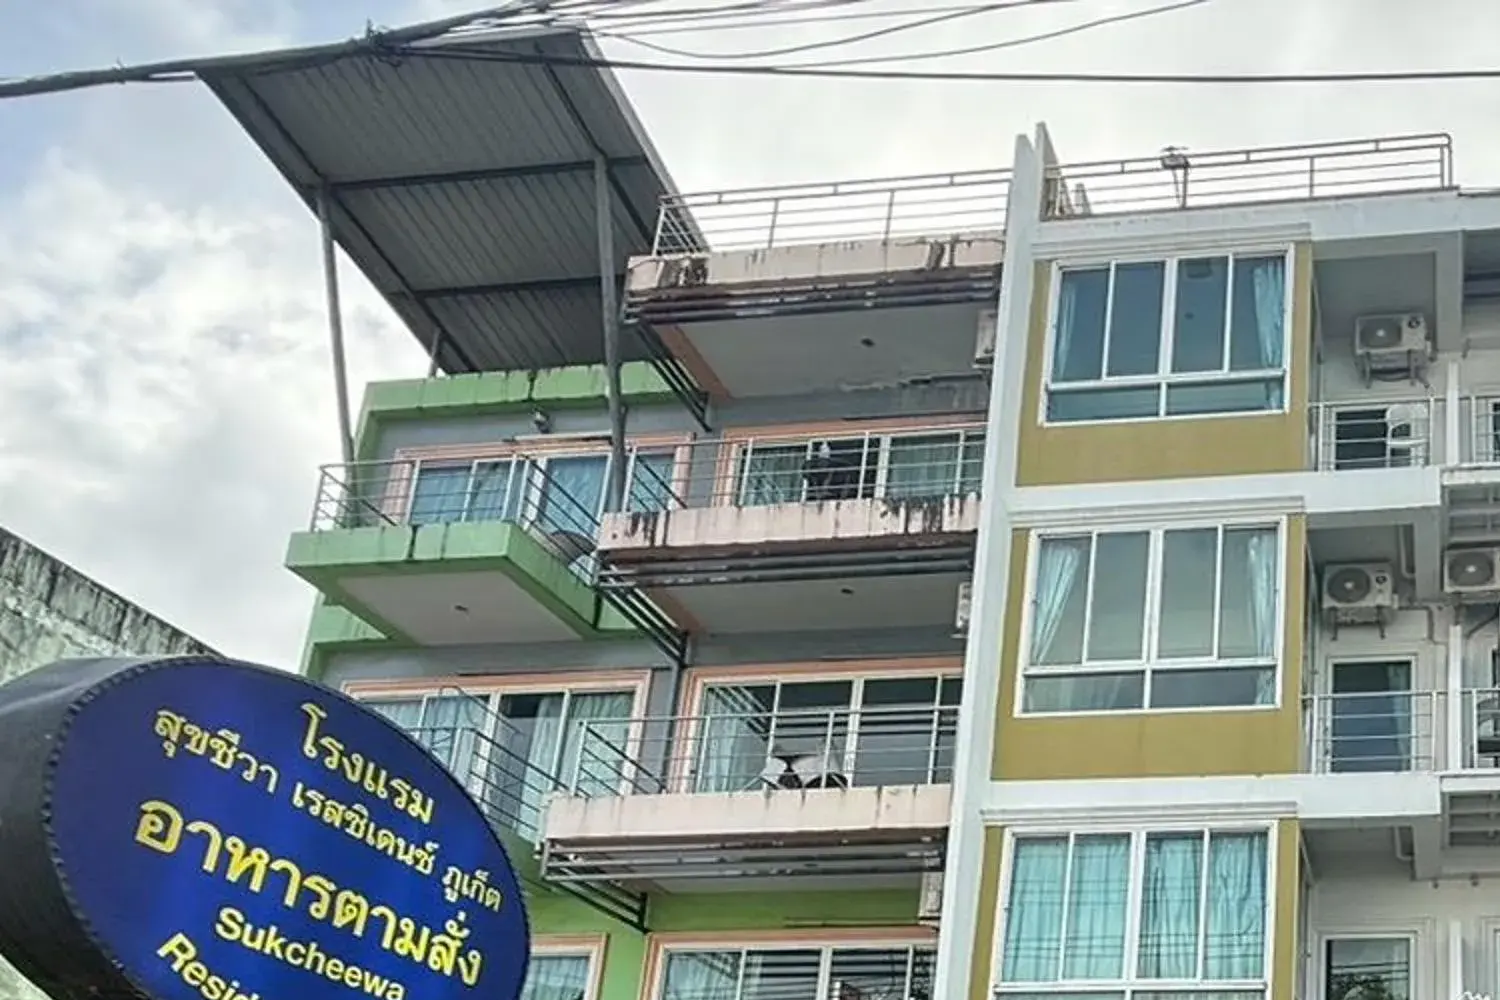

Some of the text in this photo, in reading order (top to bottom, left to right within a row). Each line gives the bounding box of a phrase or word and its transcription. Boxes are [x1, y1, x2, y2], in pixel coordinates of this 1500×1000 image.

[152, 707, 279, 794] สุขชีวา
[441, 863, 502, 913] ภูเก็ต
[300, 703, 434, 824] โรงแรม
[133, 797, 484, 988] อาหารตามสั่ง
